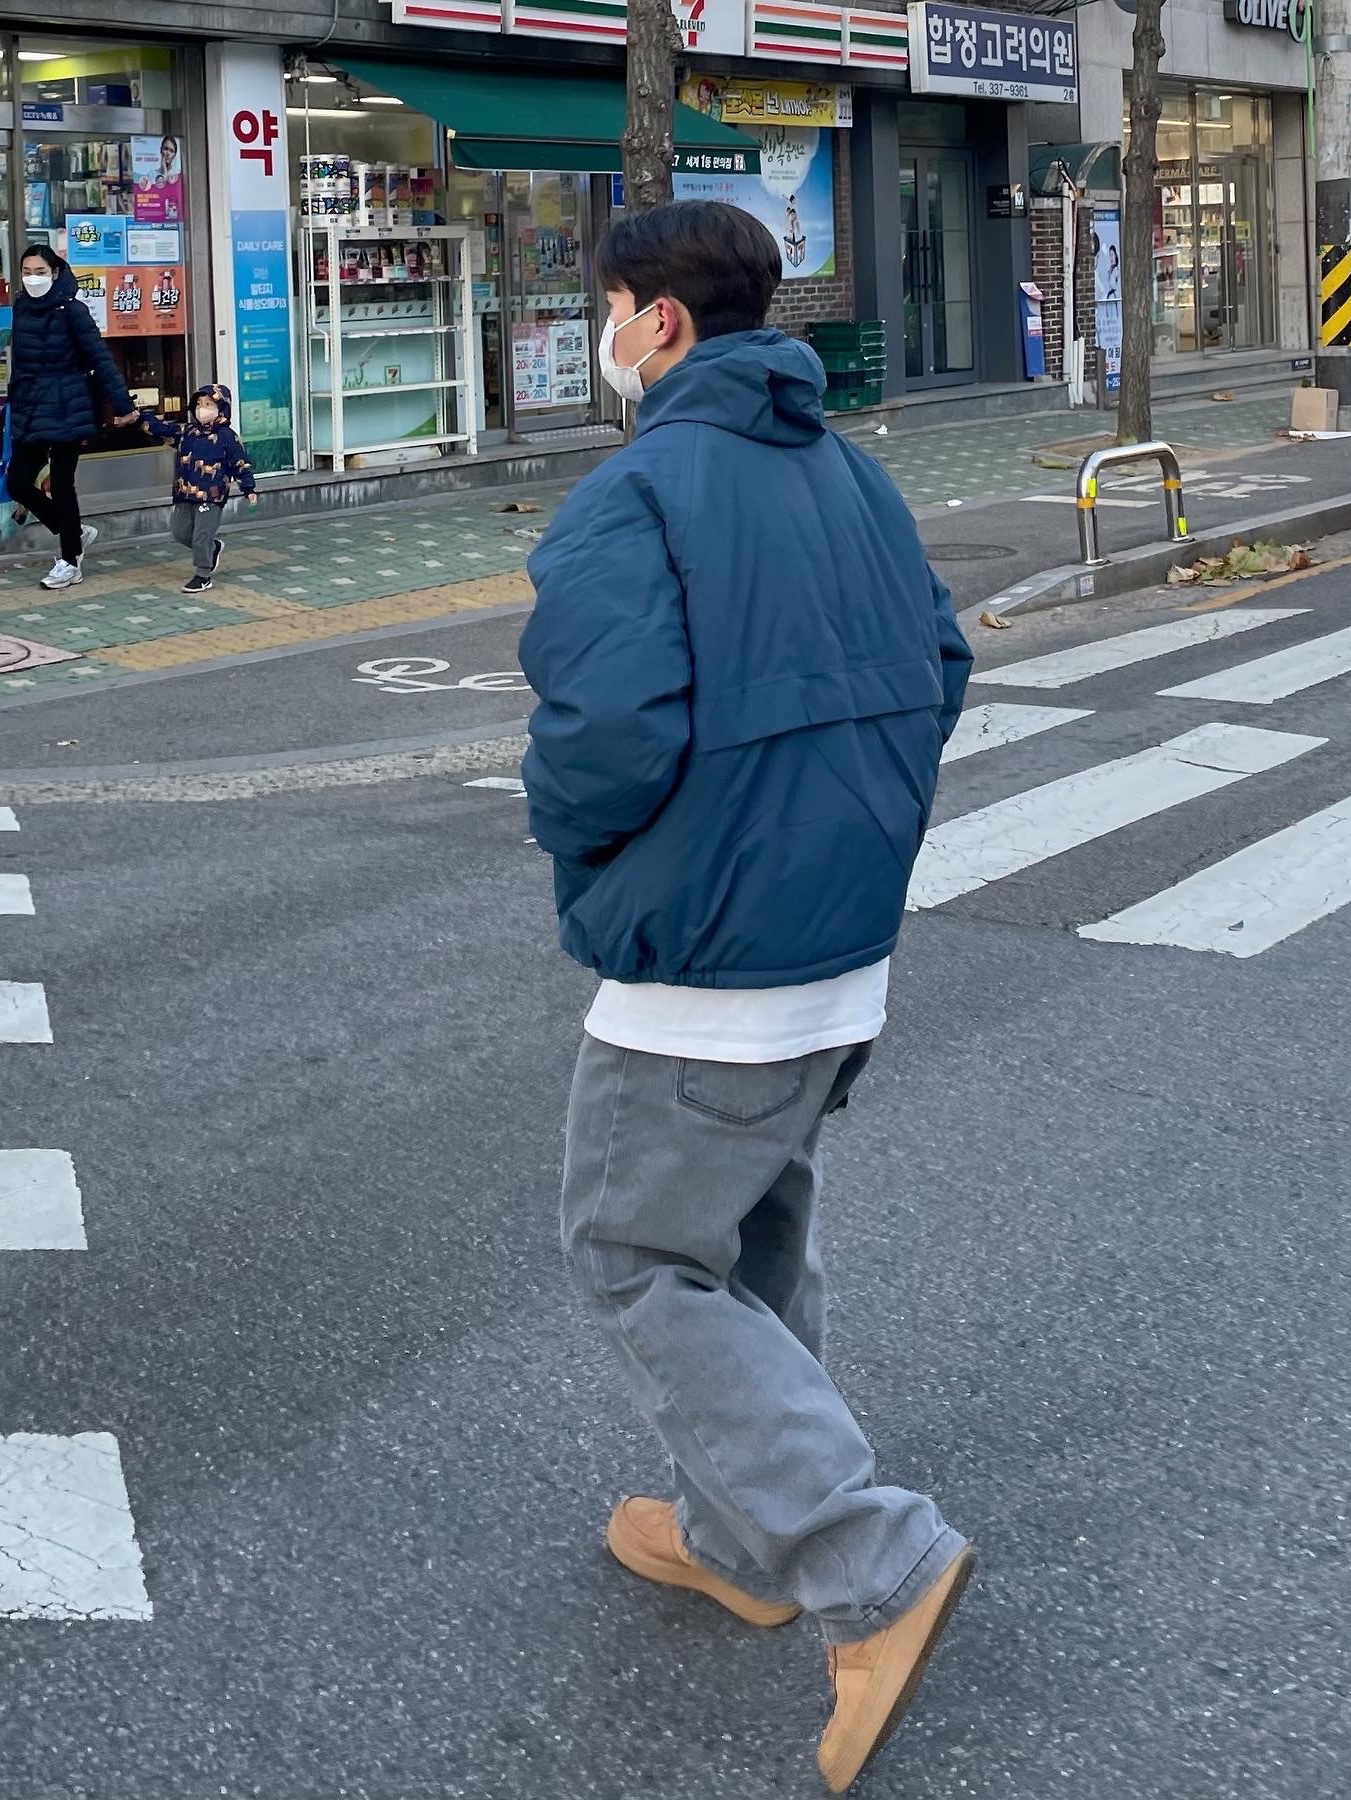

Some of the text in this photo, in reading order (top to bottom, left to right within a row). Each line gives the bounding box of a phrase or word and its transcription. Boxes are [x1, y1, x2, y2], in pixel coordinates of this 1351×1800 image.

[1238, 0, 1287, 29] OLIVE
[928, 14, 1074, 76] 합정고려의원
[974, 81, 1029, 98] Tel. 337-9361
[232, 109, 279, 177] 약
[686, 155, 699, 168] 세계
[701, 154, 711, 169] 1등
[713, 156, 732, 169] 편의점
[237, 241, 284, 251] DAILY CARE
